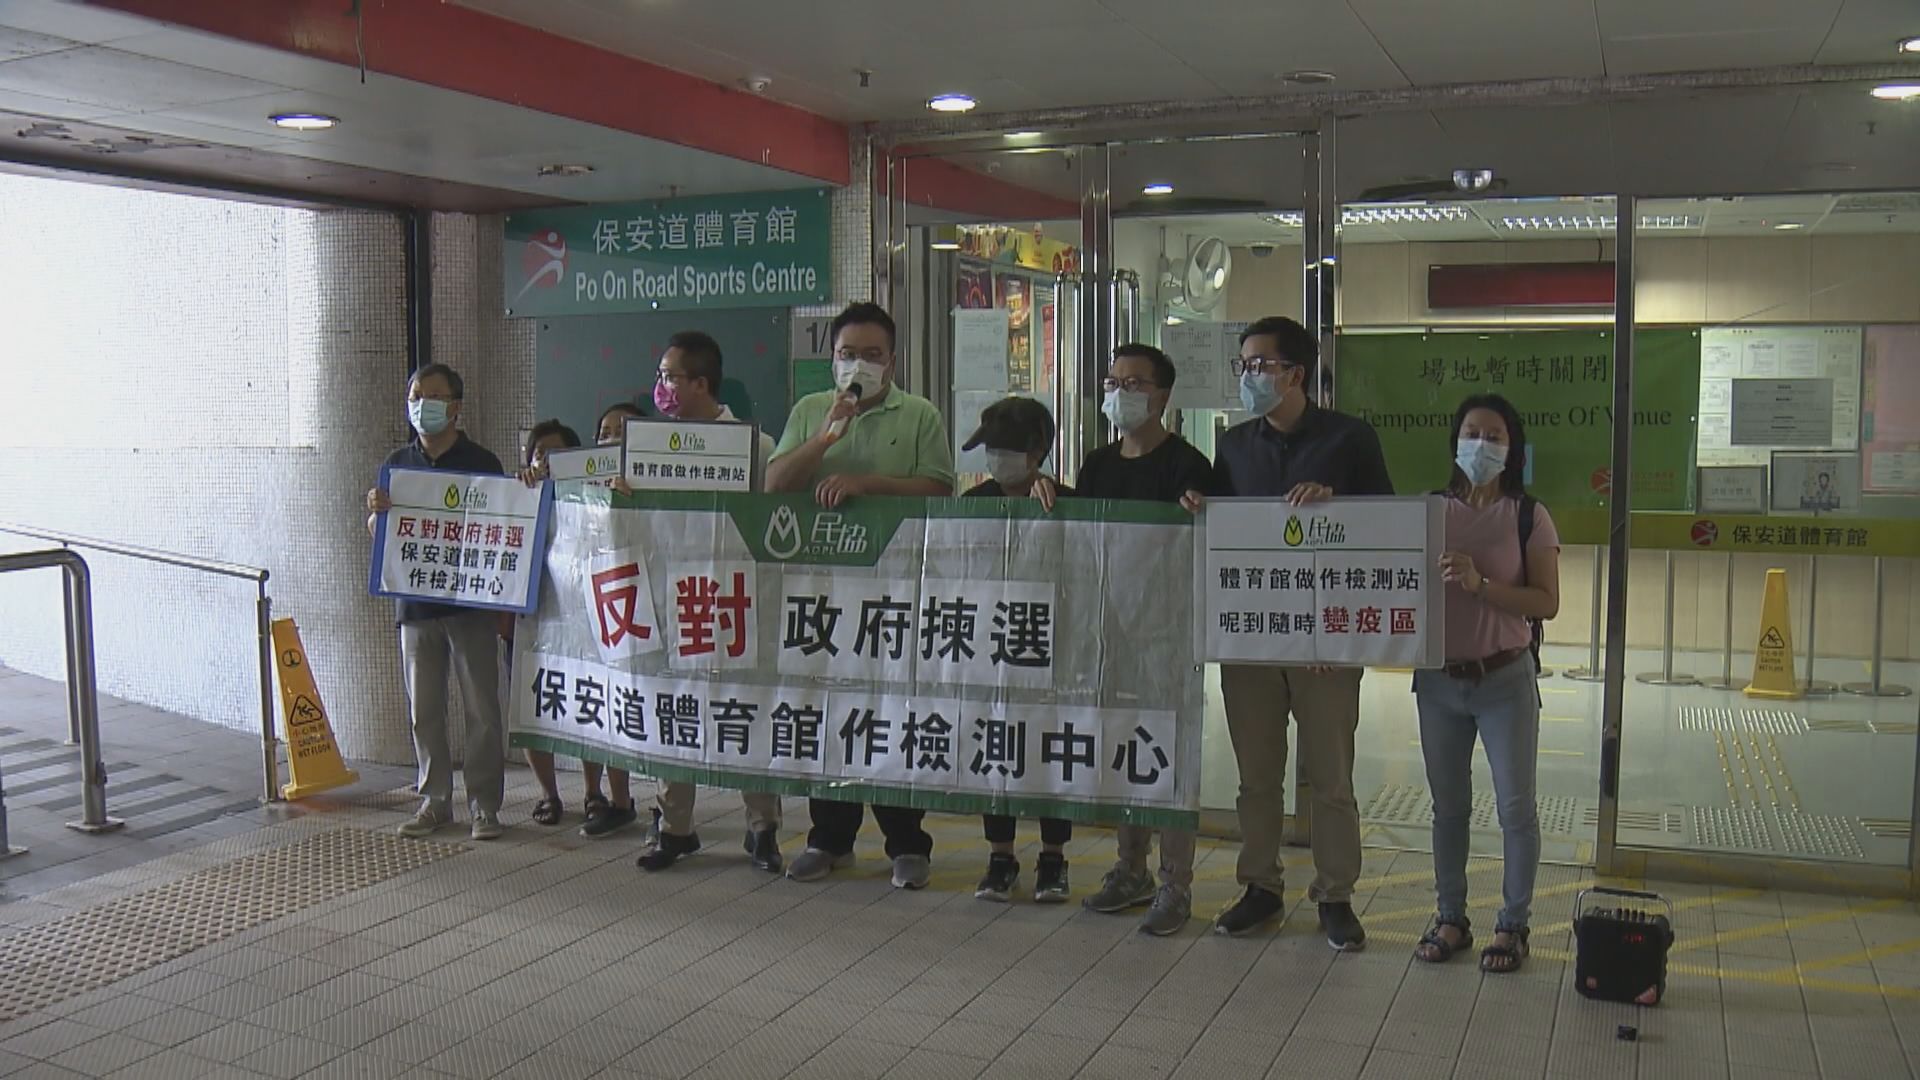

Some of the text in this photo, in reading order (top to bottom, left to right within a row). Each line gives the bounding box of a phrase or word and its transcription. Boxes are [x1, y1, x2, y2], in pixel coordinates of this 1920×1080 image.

[592, 205, 797, 255] 保安道體育館
[575, 261, 816, 303] Po On Road Sports Centre
[806, 321, 829, 353] 1/
[1419, 355, 1608, 385] 場地暫時關閉
[1568, 406, 1600, 426] Of
[633, 462, 745, 481] 體育館做作檢測站
[397, 516, 525, 548] 反對政府揀選
[811, 511, 868, 553] 民協
[1732, 524, 1868, 547] 保安道體育館
[400, 541, 518, 571] 保安道體育館
[409, 568, 504, 596] 作檢測中心
[1219, 567, 1420, 591] 體育館做作檢測站
[1219, 606, 1417, 635] 呢到隨時變疫區
[531, 667, 1171, 785] 保安道體育館作檢測中心
